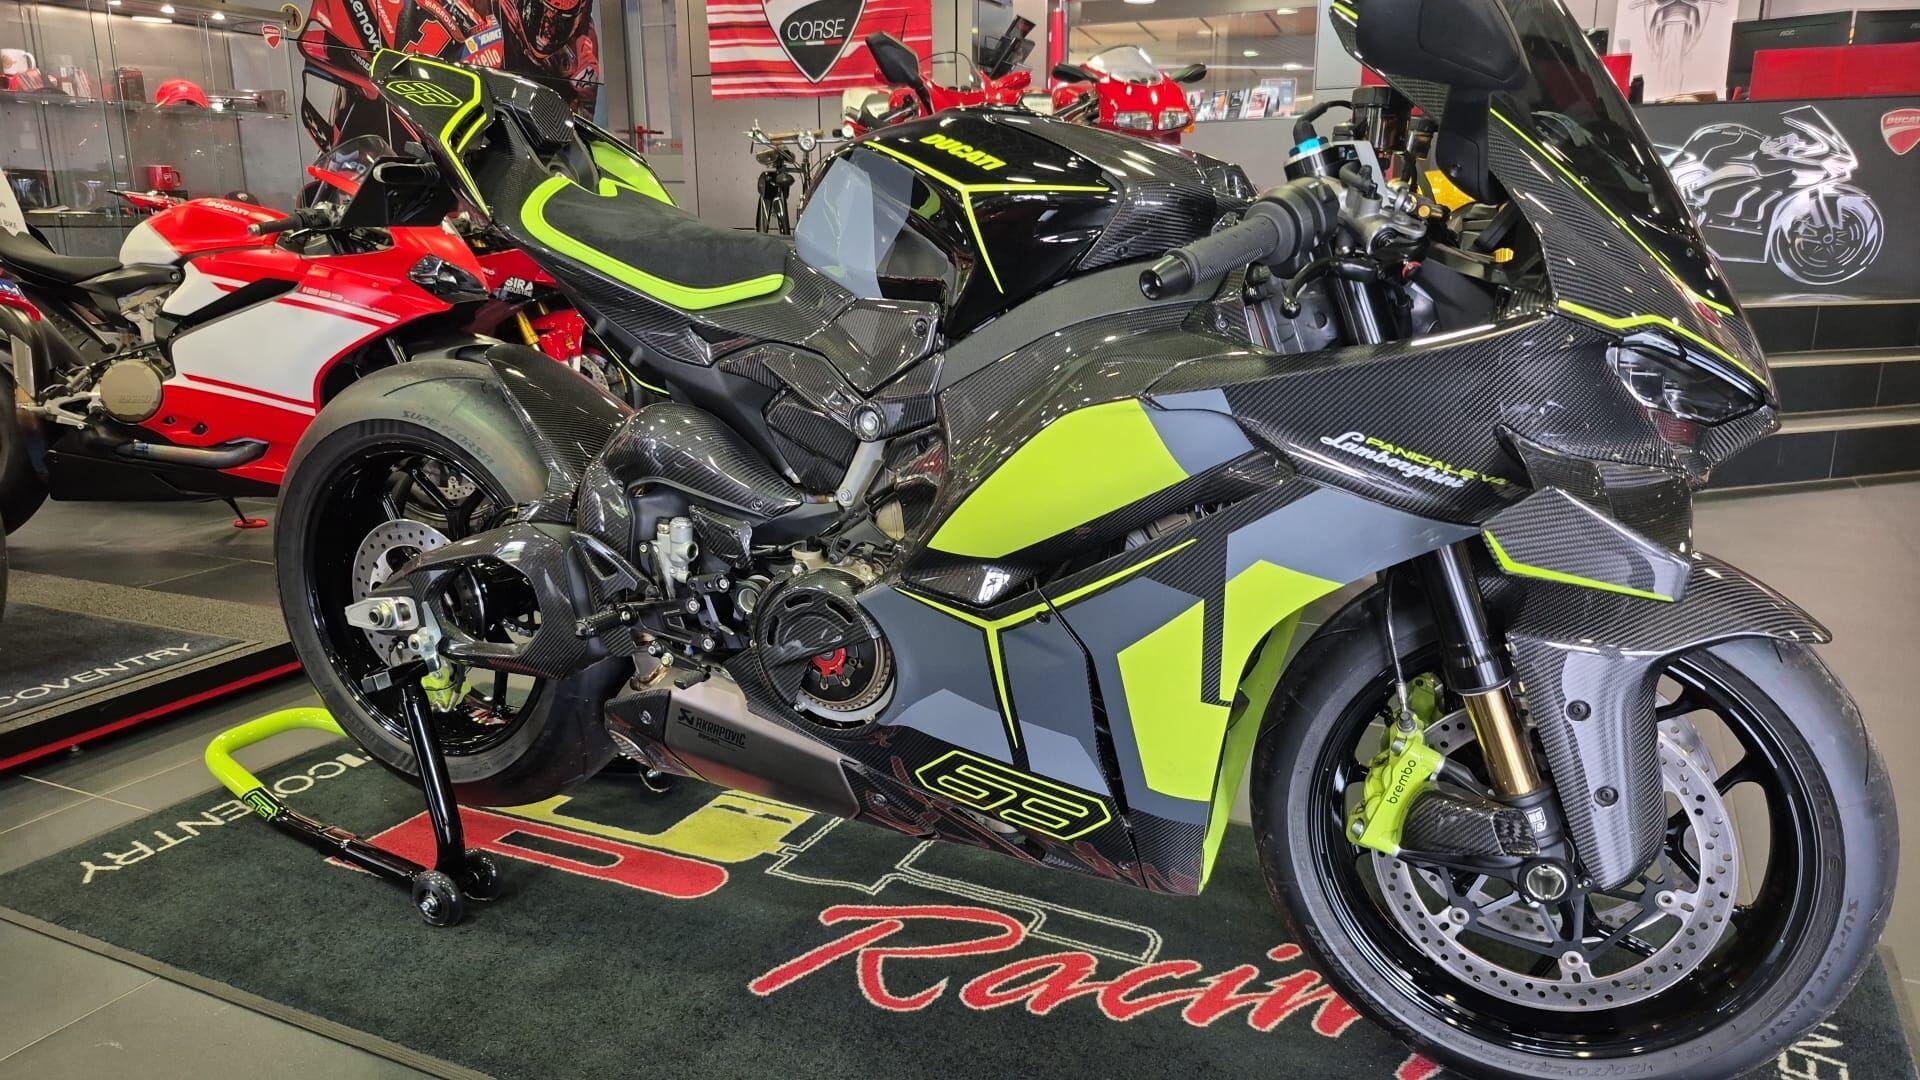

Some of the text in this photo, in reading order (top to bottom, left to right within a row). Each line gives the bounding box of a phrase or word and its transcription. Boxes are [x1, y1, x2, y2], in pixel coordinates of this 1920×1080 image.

[350, 0, 381, 51] enov
[787, 18, 846, 41] CORSE
[1886, 115, 1920, 126] DUCAT
[919, 133, 1007, 171] DUCATI
[206, 200, 250, 215] DUCATI
[504, 276, 534, 292] SIRA
[1319, 431, 1469, 489] Lamborghini
[0, 642, 191, 709] COVENTRY
[1386, 758, 1417, 805] brembo
[80, 761, 347, 885] COENTRY
[747, 904, 1443, 1080] Racin
